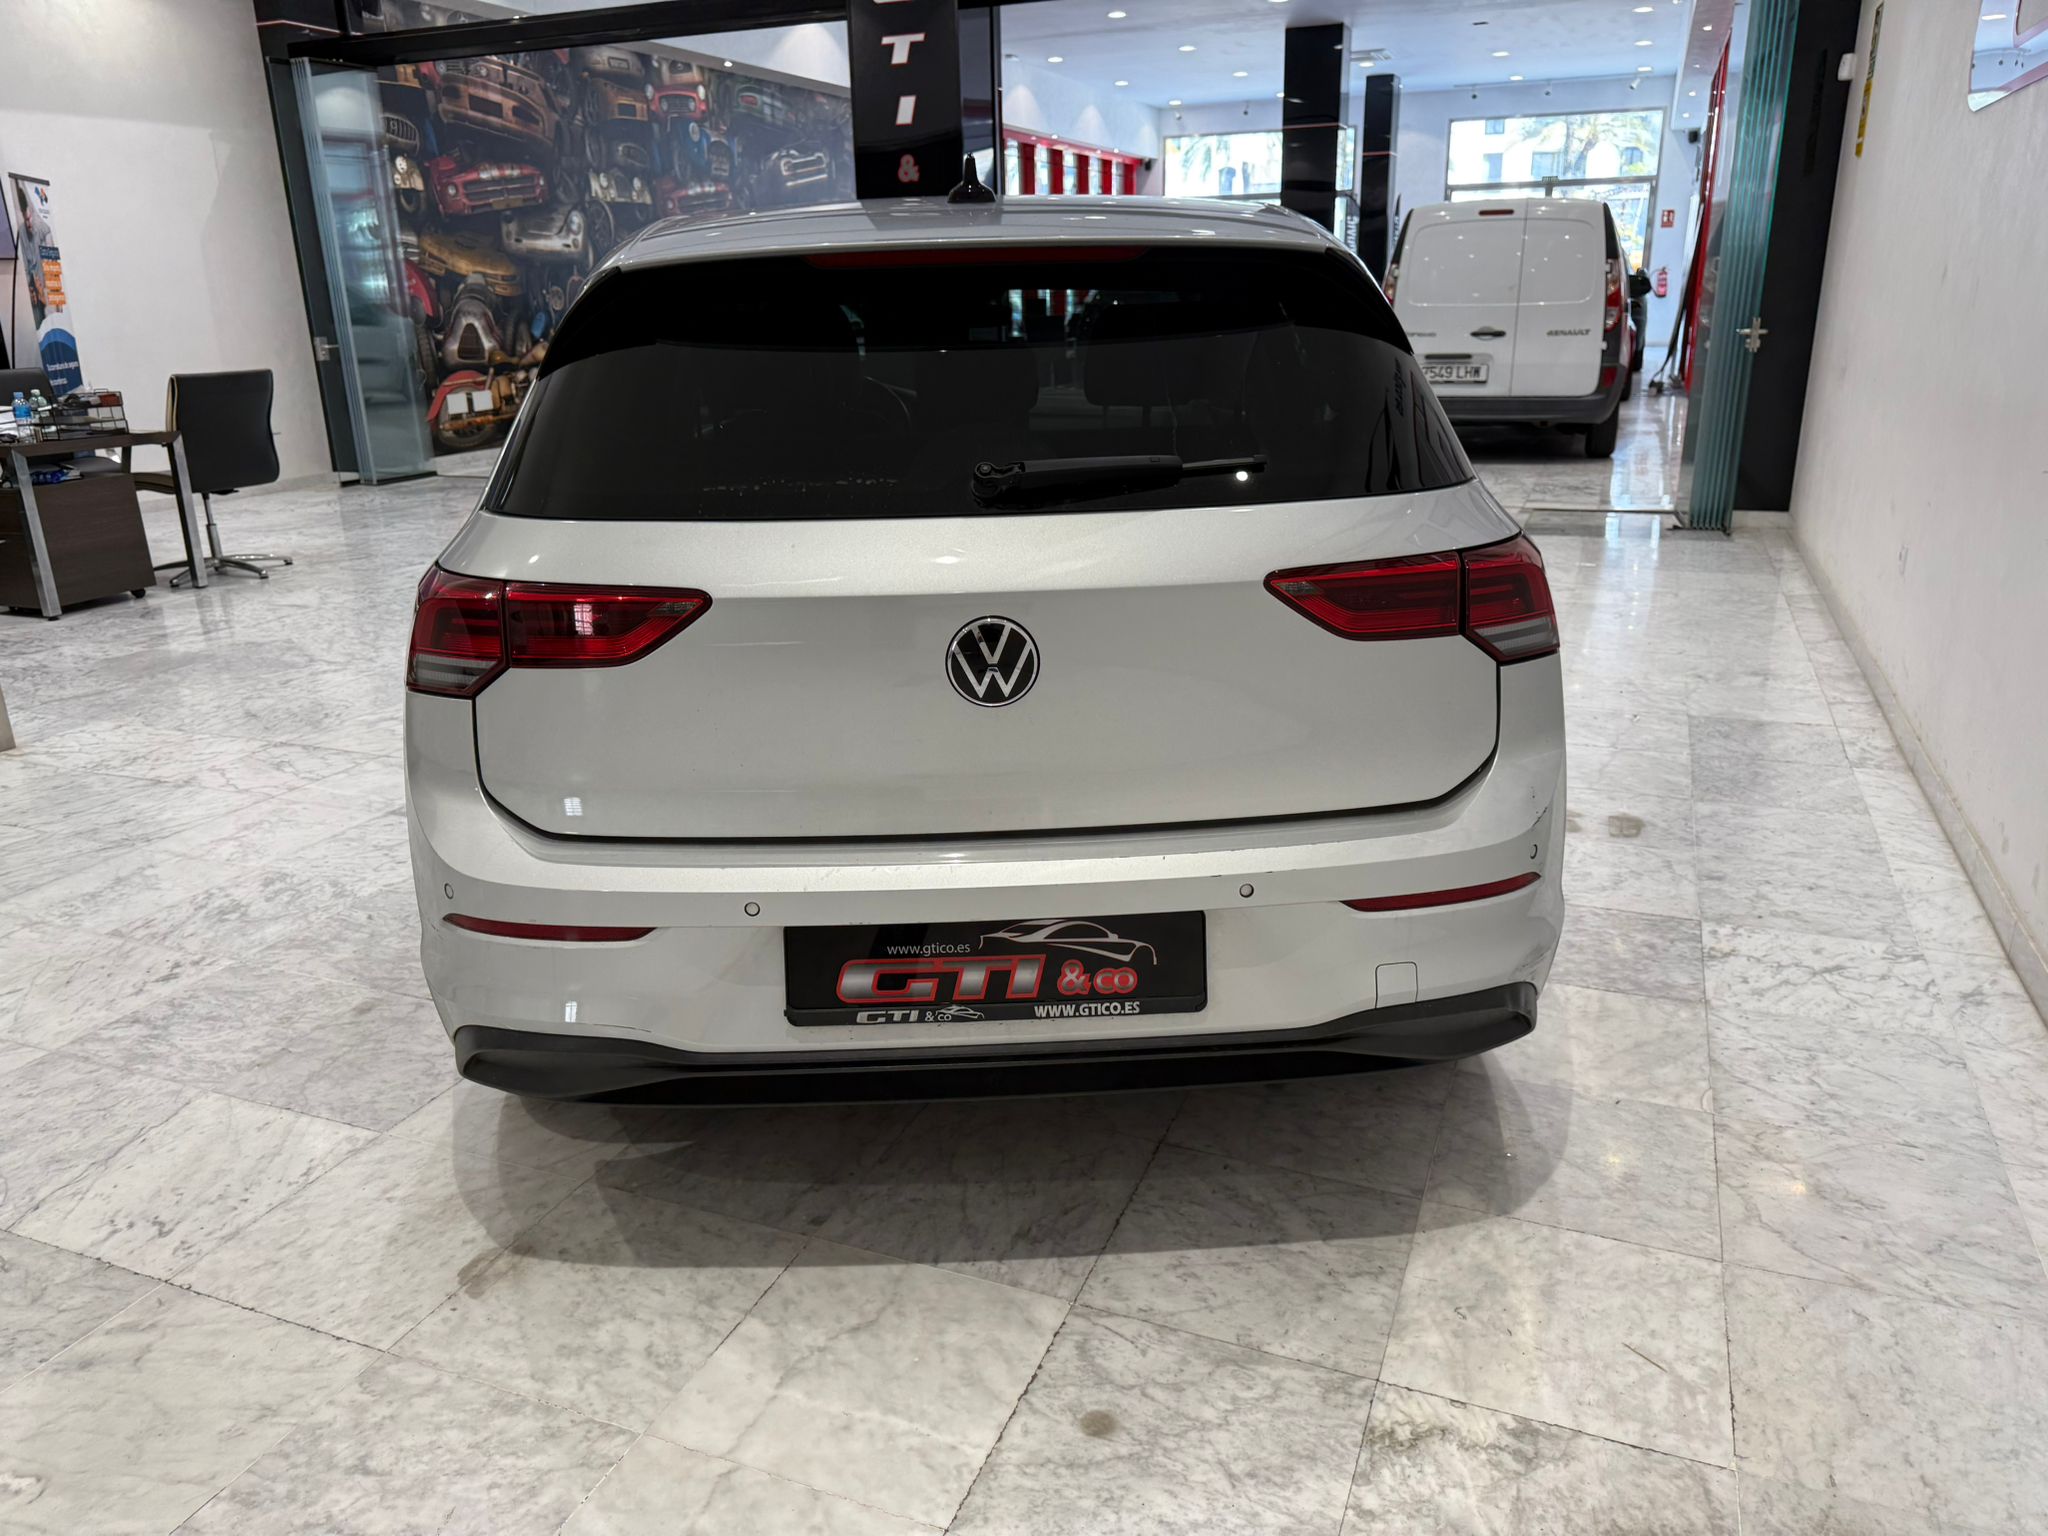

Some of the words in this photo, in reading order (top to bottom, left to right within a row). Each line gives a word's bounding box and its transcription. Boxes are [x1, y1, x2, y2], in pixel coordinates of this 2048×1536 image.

[1546, 328, 1592, 337] RENAULT
[1422, 366, 1453, 379] 7549
[887, 942, 970, 957] www.gtico.es
[836, 953, 1047, 1004] GTI
[856, 1009, 919, 1024] GTI
[1034, 1002, 1140, 1017] WWW.GTICO.ES
